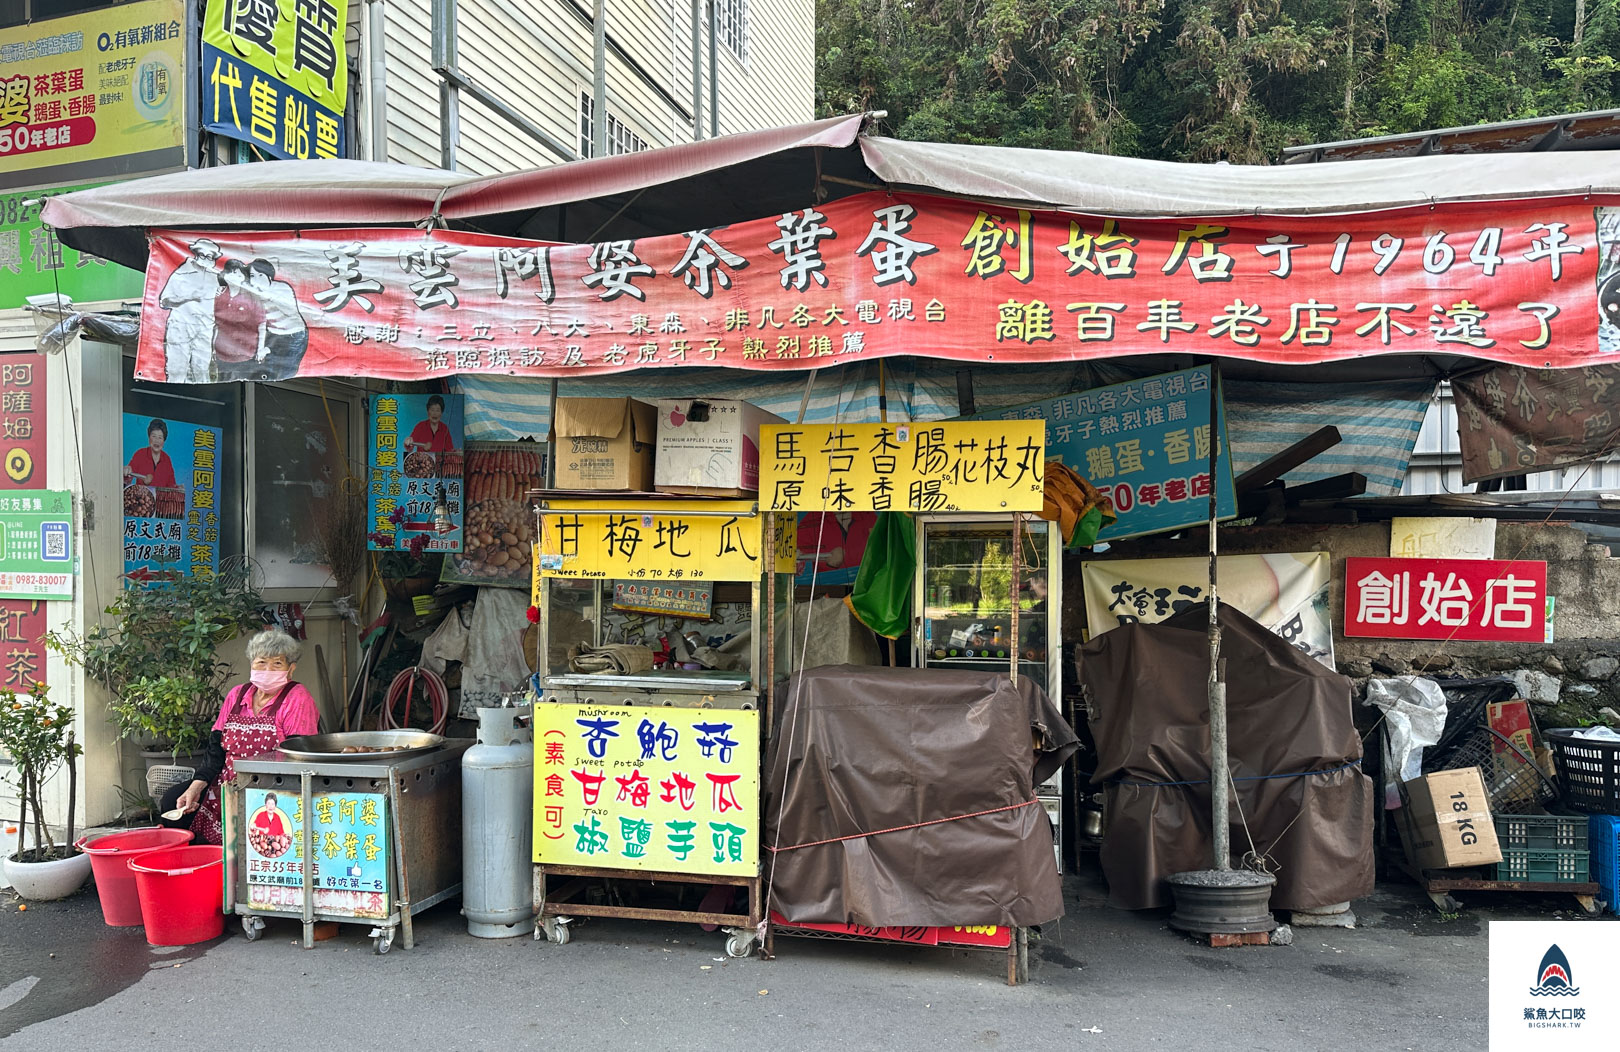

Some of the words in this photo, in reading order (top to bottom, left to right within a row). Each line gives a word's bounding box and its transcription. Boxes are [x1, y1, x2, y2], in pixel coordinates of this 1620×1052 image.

[0, 31, 84, 64] 電視台蒞臨採訪
[34, 68, 84, 97] 茶葉蛋
[34, 94, 96, 122] 鵝蛋、香腸
[211, 56, 339, 160] 代售船票
[996, 299, 1561, 349] 離百年老店不遠了
[2, 363, 33, 441] 阿薩姆
[375, 398, 398, 467] 美雲阿婆
[192, 429, 215, 509] 美雲阿婆
[406, 500, 460, 514] 前18攤
[124, 519, 181, 541] 原文武廟
[555, 514, 758, 562] 甘梅地瓜
[15, 575, 67, 585] 0982-830017
[650, 569, 662, 577] 70
[690, 569, 704, 577] 130
[1356, 570, 1537, 629] 創始店
[575, 717, 740, 764] 杏鮑菇
[570, 767, 743, 814] 甘梅地瓜
[1450, 791, 1468, 813] 18
[583, 808, 608, 816] Taro
[323, 832, 382, 861] 茶葉蛋
[573, 815, 747, 864] 椒鹽芋頭
[1456, 818, 1478, 846] KG
[326, 876, 383, 890] 好吃第一名
